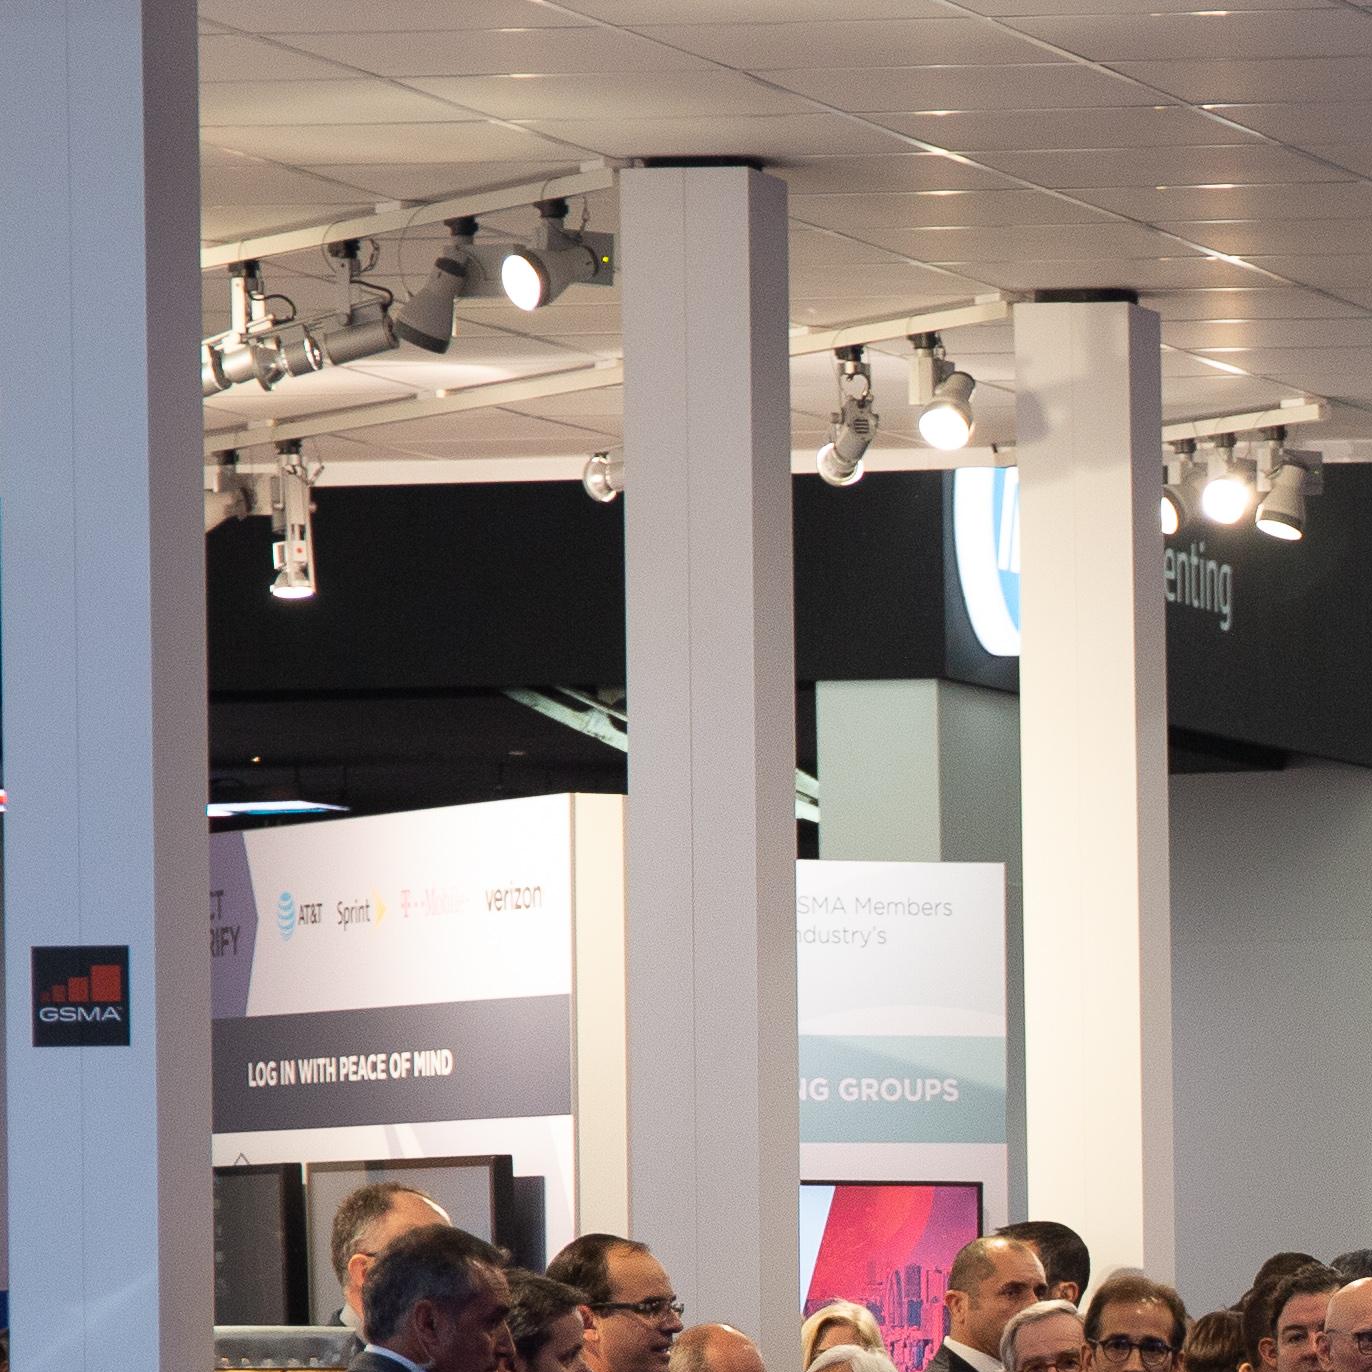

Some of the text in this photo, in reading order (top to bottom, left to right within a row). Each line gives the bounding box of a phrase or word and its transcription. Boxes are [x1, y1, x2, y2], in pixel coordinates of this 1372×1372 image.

[298, 903, 323, 925] AT&T
[337, 899, 371, 931] Sprint
[485, 881, 542, 911] verizon
[855, 896, 953, 917] Members
[39, 1006, 121, 1022] GSMA
[248, 1048, 454, 1087] LOG IN WITH PEACE OF MIND
[838, 1077, 960, 1102] GROUPS
